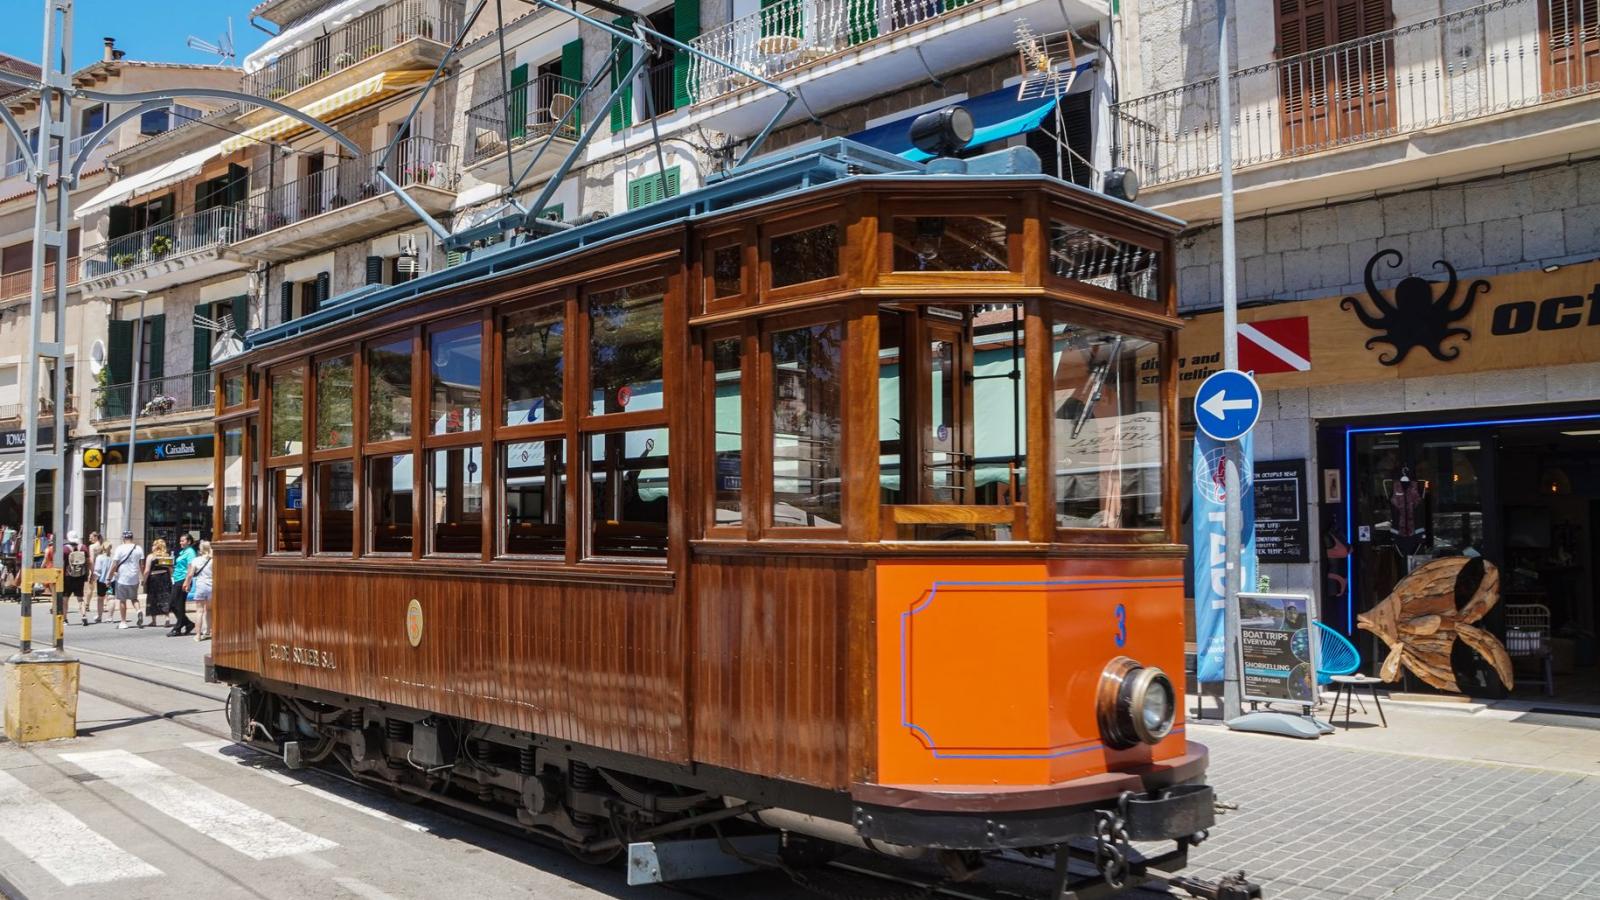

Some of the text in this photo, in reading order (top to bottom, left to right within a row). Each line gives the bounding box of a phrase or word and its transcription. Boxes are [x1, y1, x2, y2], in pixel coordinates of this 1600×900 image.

[1191, 352, 1220, 365] and
[165, 442, 196, 455] CaixaBank
[1114, 603, 1126, 648] 3
[1243, 630, 1289, 641] BOAT TRIPS
[1243, 638, 1277, 646] EVERYDAY
[1245, 662, 1290, 671] SNORKELLING
